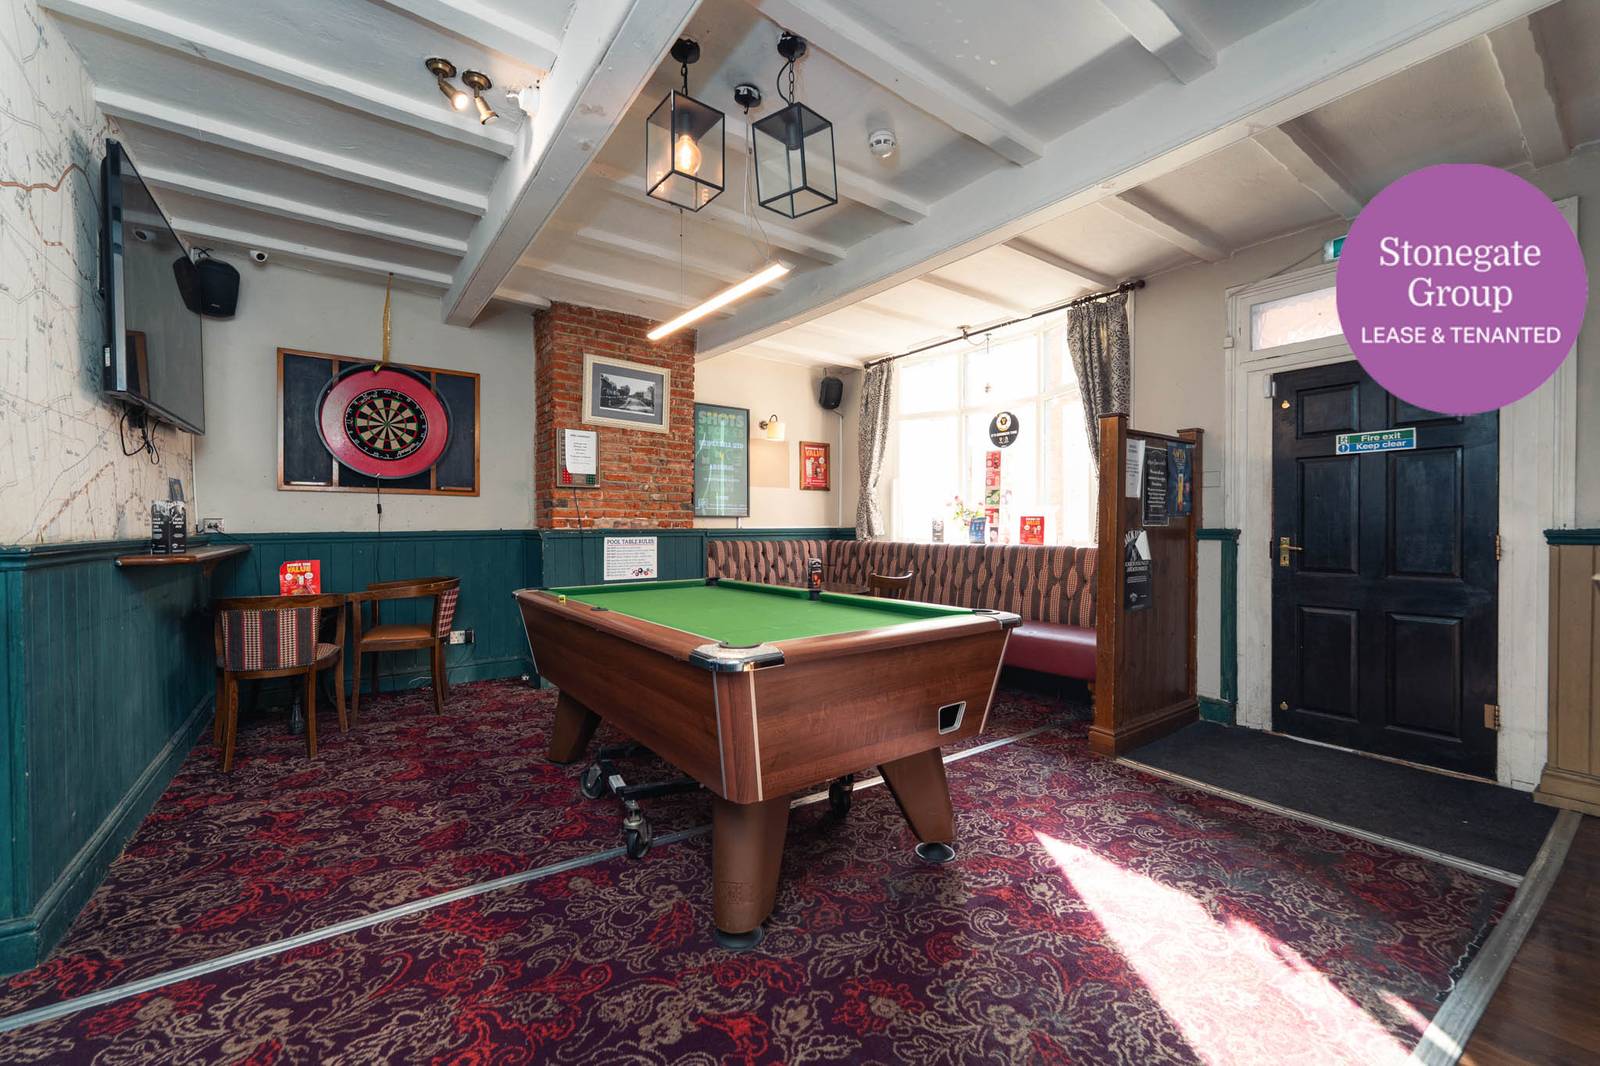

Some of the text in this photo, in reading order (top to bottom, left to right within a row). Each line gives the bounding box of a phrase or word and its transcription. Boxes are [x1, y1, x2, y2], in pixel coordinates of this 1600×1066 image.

[698, 410, 745, 428] SHOTS
[1382, 432, 1401, 440] exit
[1382, 440, 1407, 448] clear
